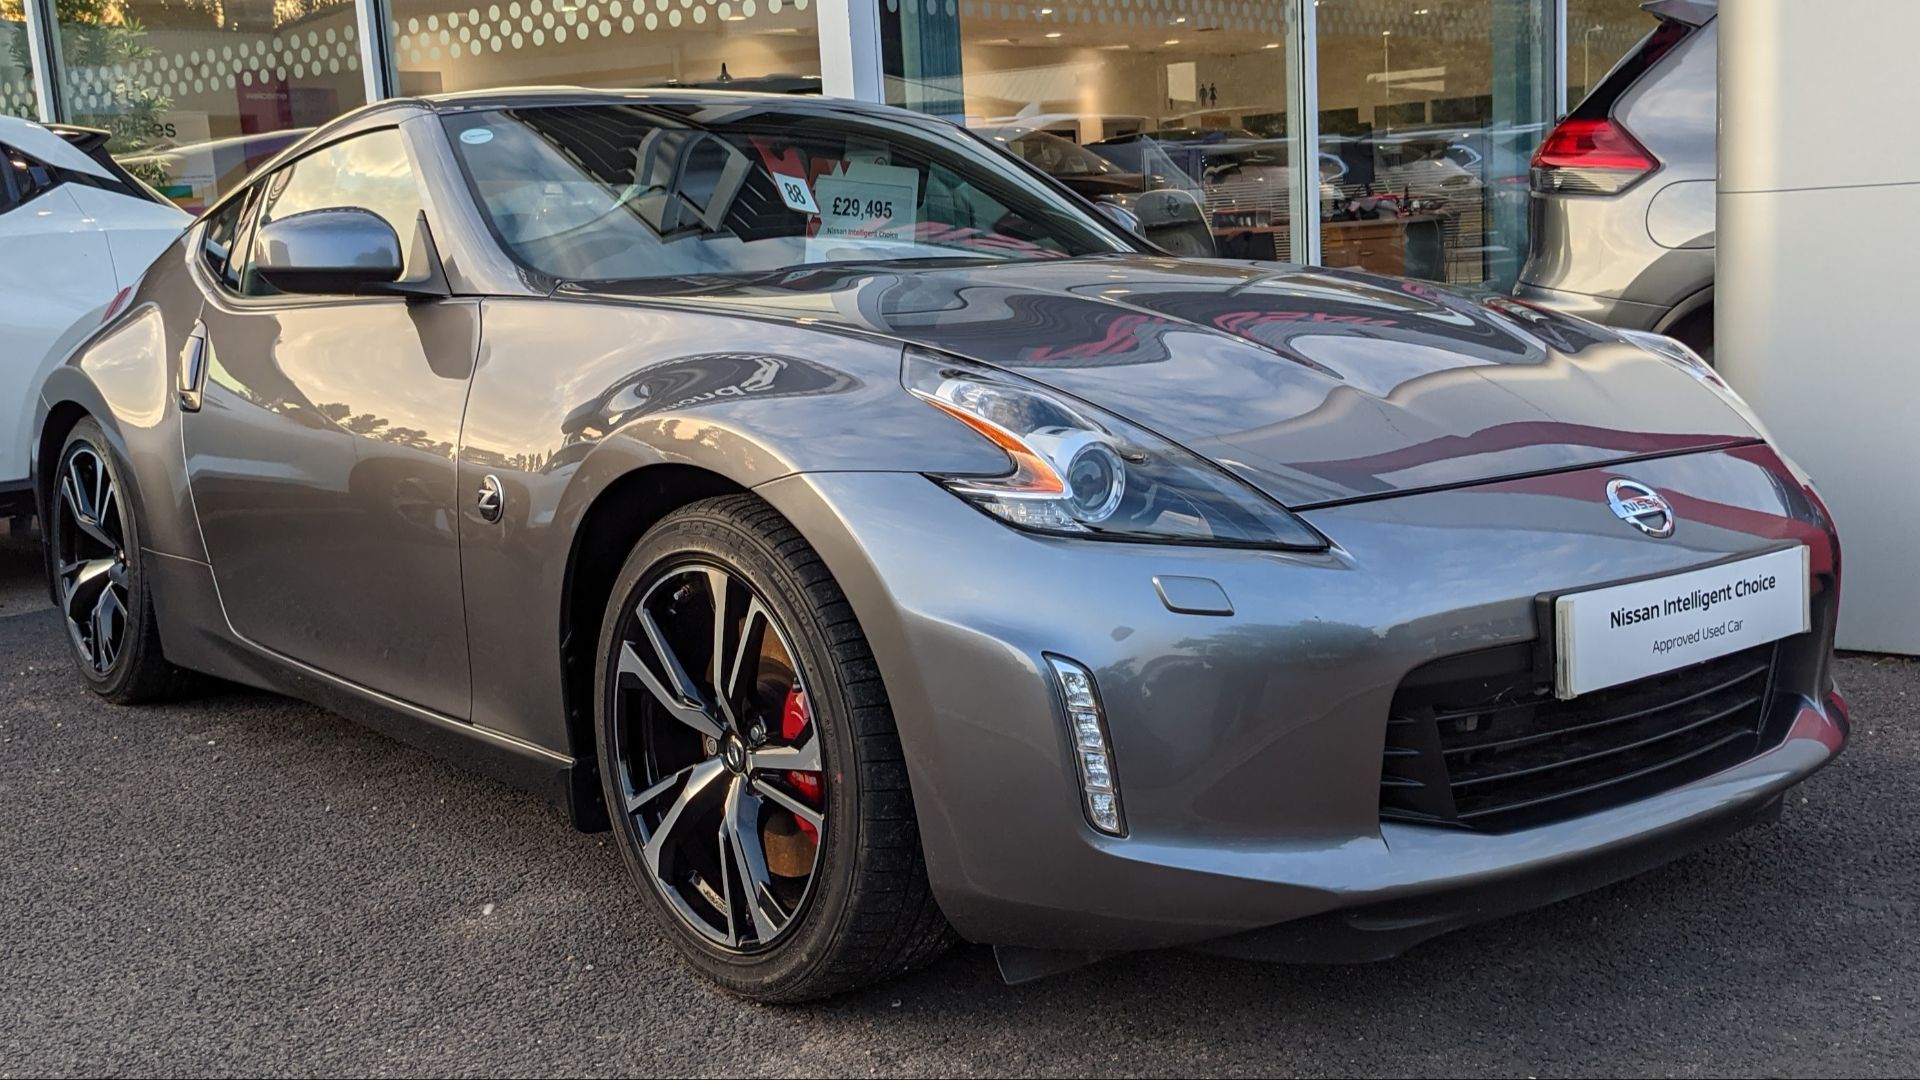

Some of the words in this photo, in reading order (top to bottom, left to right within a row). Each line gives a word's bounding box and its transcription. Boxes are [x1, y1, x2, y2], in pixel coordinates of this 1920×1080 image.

[784, 182, 806, 205] 88
[832, 197, 893, 220] £29,495
[827, 226, 847, 235] Nissan
[879, 230, 899, 240] Choice
[677, 520, 768, 570] POTENZA
[1610, 604, 1660, 629] Nissan
[1663, 585, 1732, 617] Intelligent
[1735, 574, 1776, 598] Choice
[1652, 629, 1700, 654] Approved
[1702, 621, 1726, 641] Used
[1727, 618, 1743, 634] Car
